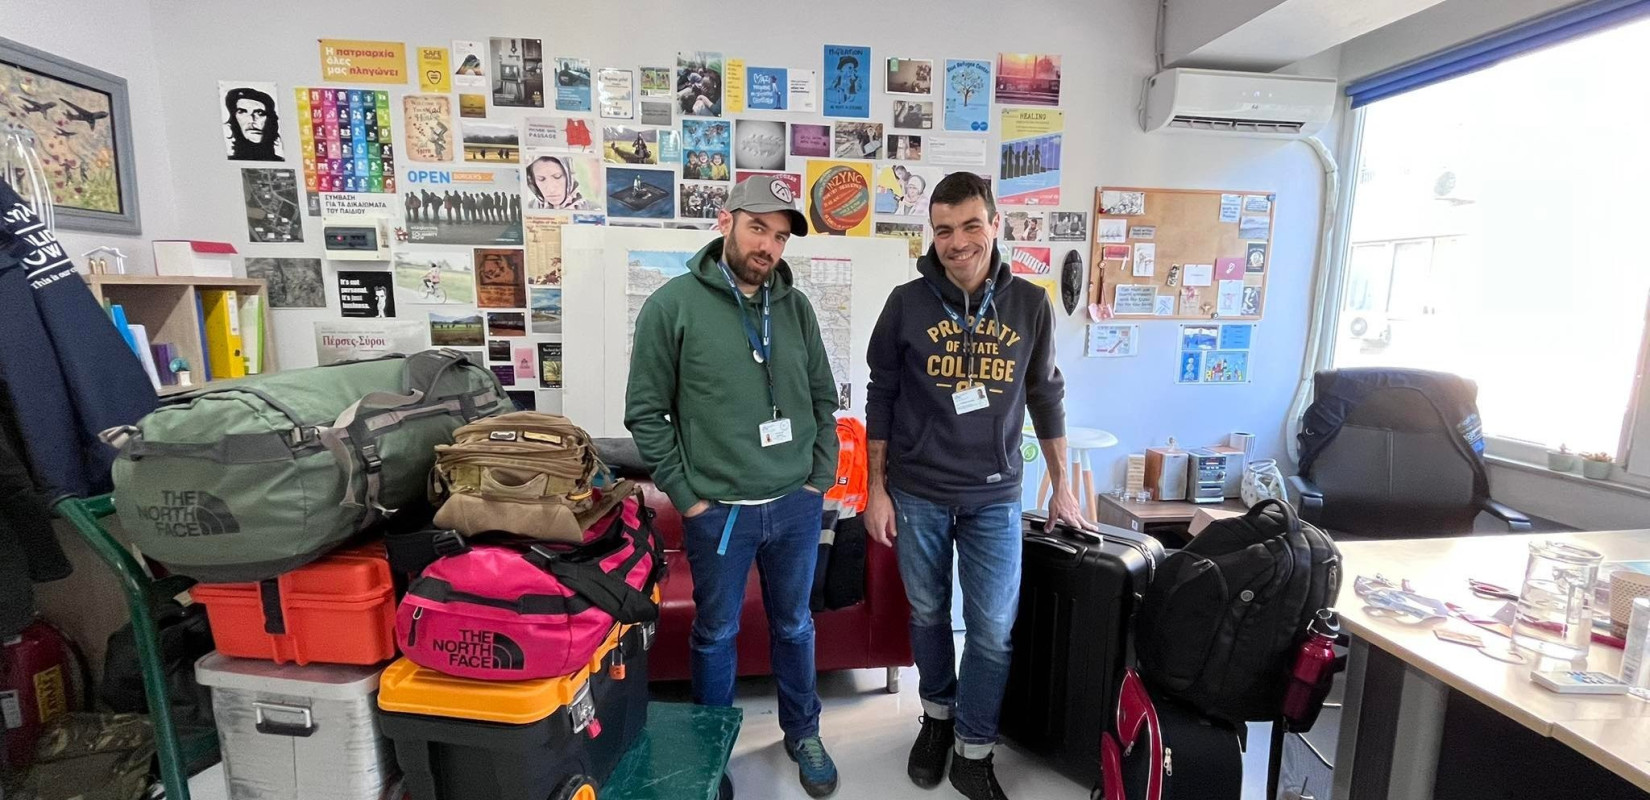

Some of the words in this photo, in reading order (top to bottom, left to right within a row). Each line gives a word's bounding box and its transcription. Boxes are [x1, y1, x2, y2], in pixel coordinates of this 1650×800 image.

[325, 47, 334, 56] Η
[336, 48, 395, 58] πατριαρχία
[326, 57, 351, 67] όλες
[327, 67, 347, 77] μας
[349, 66, 398, 78] πληγώνει
[407, 170, 450, 184] OPEN
[826, 171, 862, 191] INZYNC
[323, 335, 386, 348] Πέρσες-Σύροι
[946, 340, 961, 353] OF
[162, 490, 198, 506] THE
[136, 504, 196, 521] NORTH
[155, 522, 202, 538] FACE
[459, 629, 492, 644] THE
[433, 639, 492, 657] NORTH
[449, 654, 492, 669] FACE
